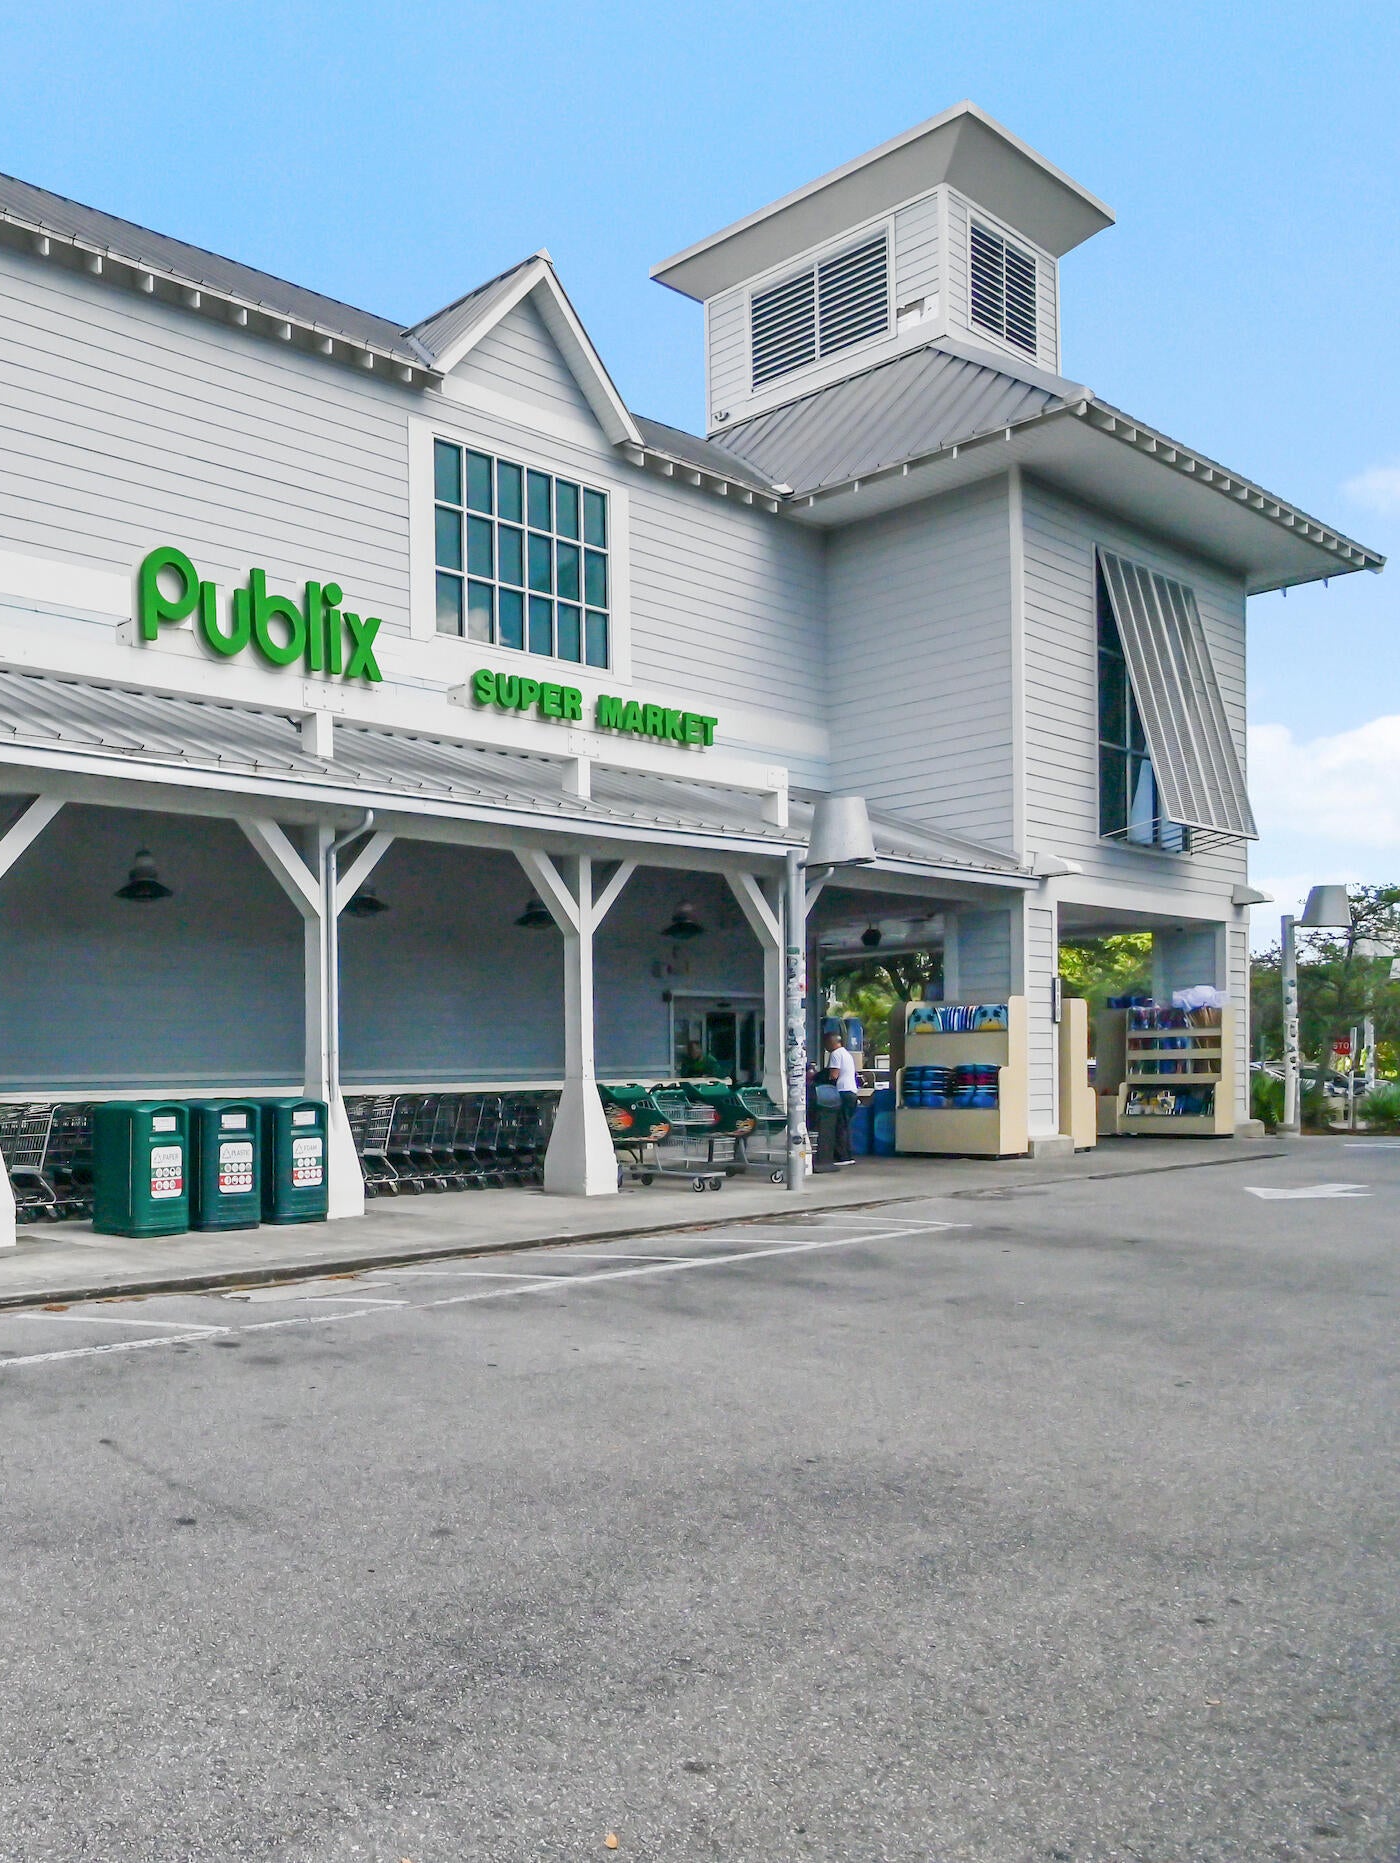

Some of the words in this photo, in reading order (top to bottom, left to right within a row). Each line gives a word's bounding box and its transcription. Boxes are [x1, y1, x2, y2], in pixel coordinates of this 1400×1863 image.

[140, 546, 383, 683] Publix
[473, 669, 583, 721] SUPER
[597, 695, 718, 747] MARKET
[1333, 1041, 1350, 1050] STO
[162, 1152, 179, 1161] PAPER
[231, 1148, 251, 1157] PLASTIC
